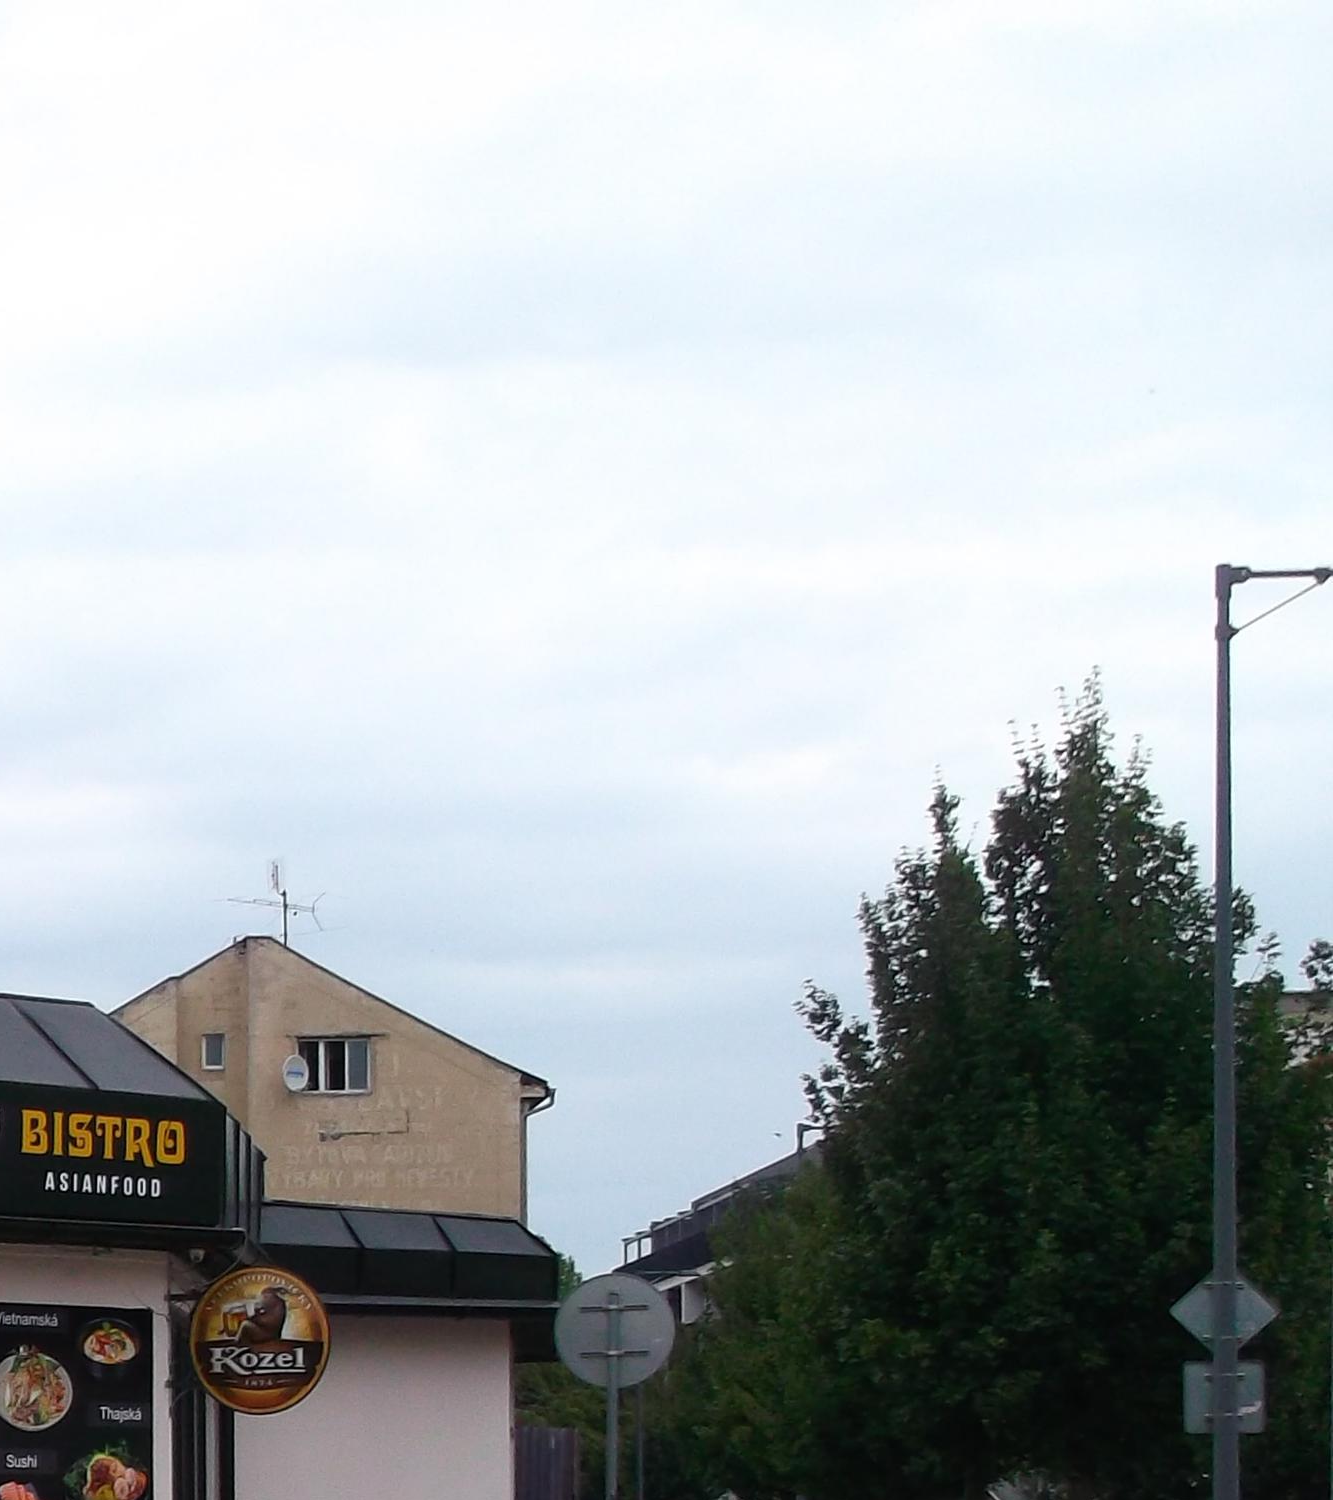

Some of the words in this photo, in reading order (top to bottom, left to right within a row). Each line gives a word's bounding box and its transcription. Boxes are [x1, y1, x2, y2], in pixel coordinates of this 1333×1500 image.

[20, 1108, 186, 1168] BISTRO
[44, 1171, 163, 1198] ASIANFOOD
[208, 1346, 307, 1375] Kozel
[99, 1406, 143, 1423] Thajská
[5, 1454, 38, 1469] Sushi
